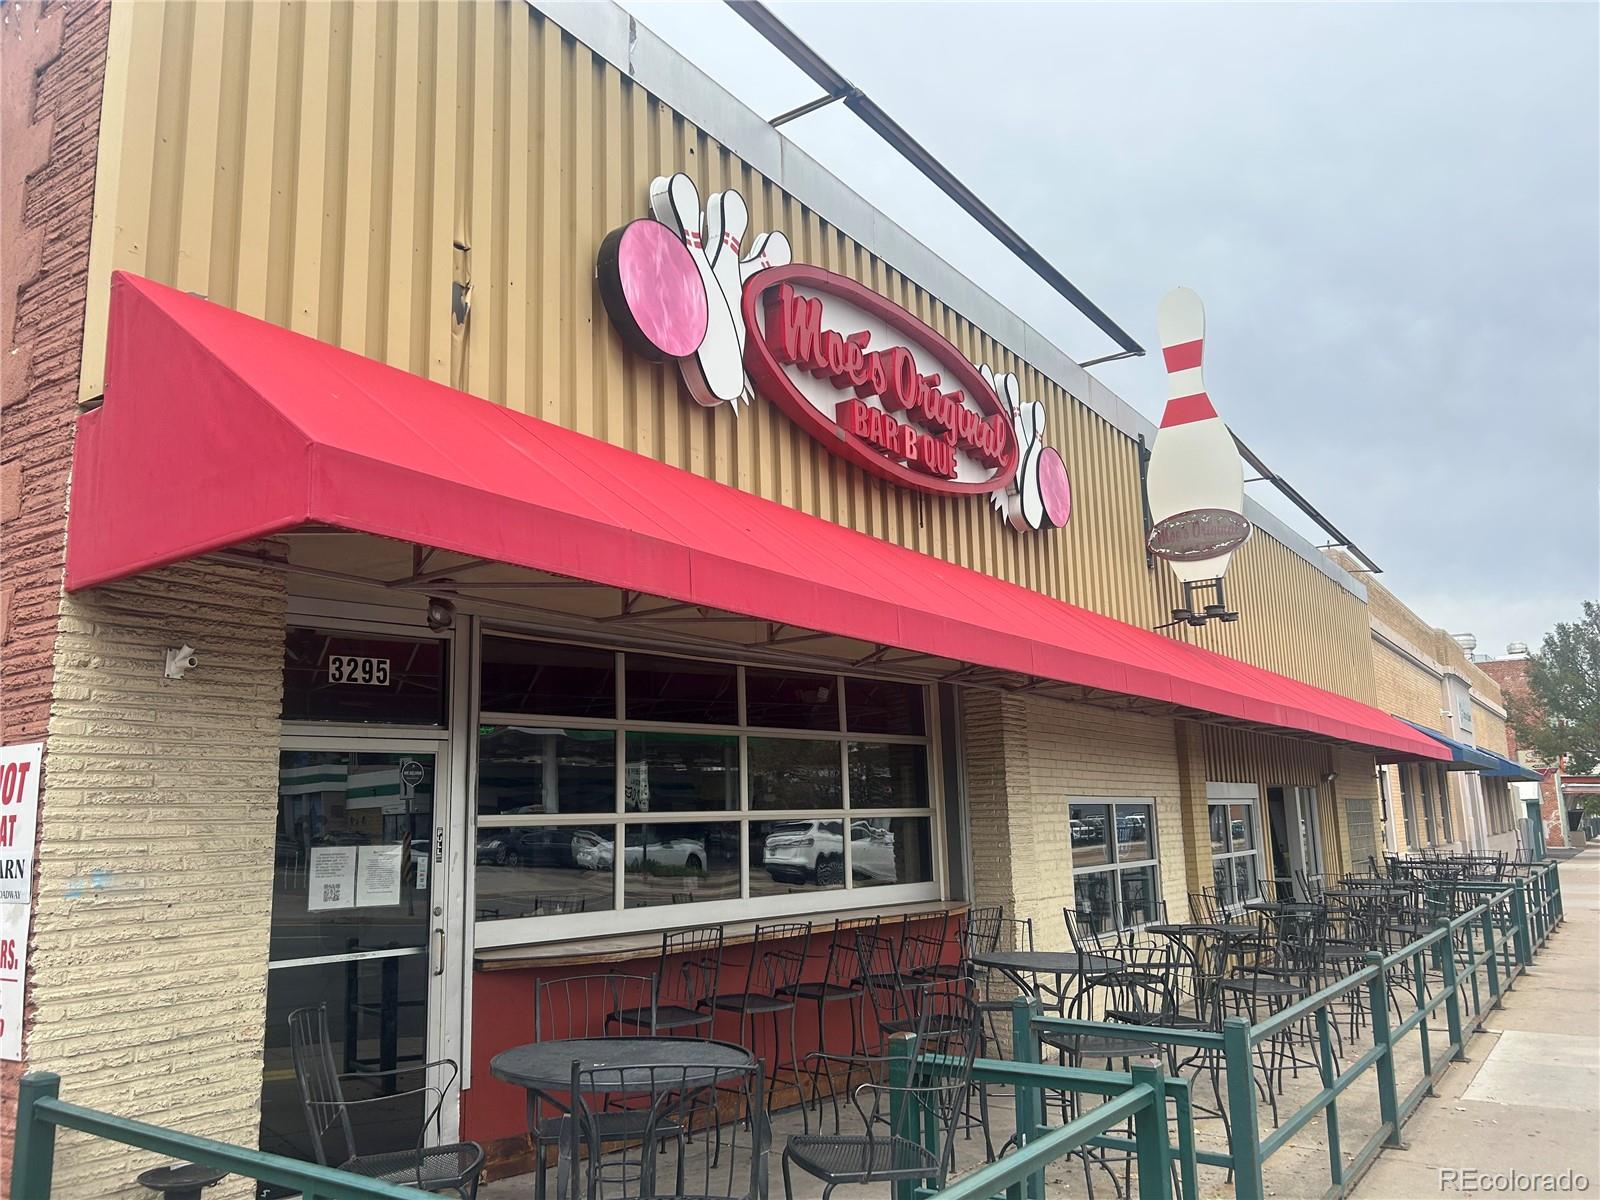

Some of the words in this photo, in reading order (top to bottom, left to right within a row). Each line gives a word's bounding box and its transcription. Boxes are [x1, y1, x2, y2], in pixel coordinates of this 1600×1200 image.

[768, 281, 887, 398] Moe's
[890, 346, 1008, 468] Original
[845, 399, 901, 454] BAR
[902, 423, 919, 462] B
[919, 434, 958, 480] QUE
[331, 656, 388, 685] 3295
